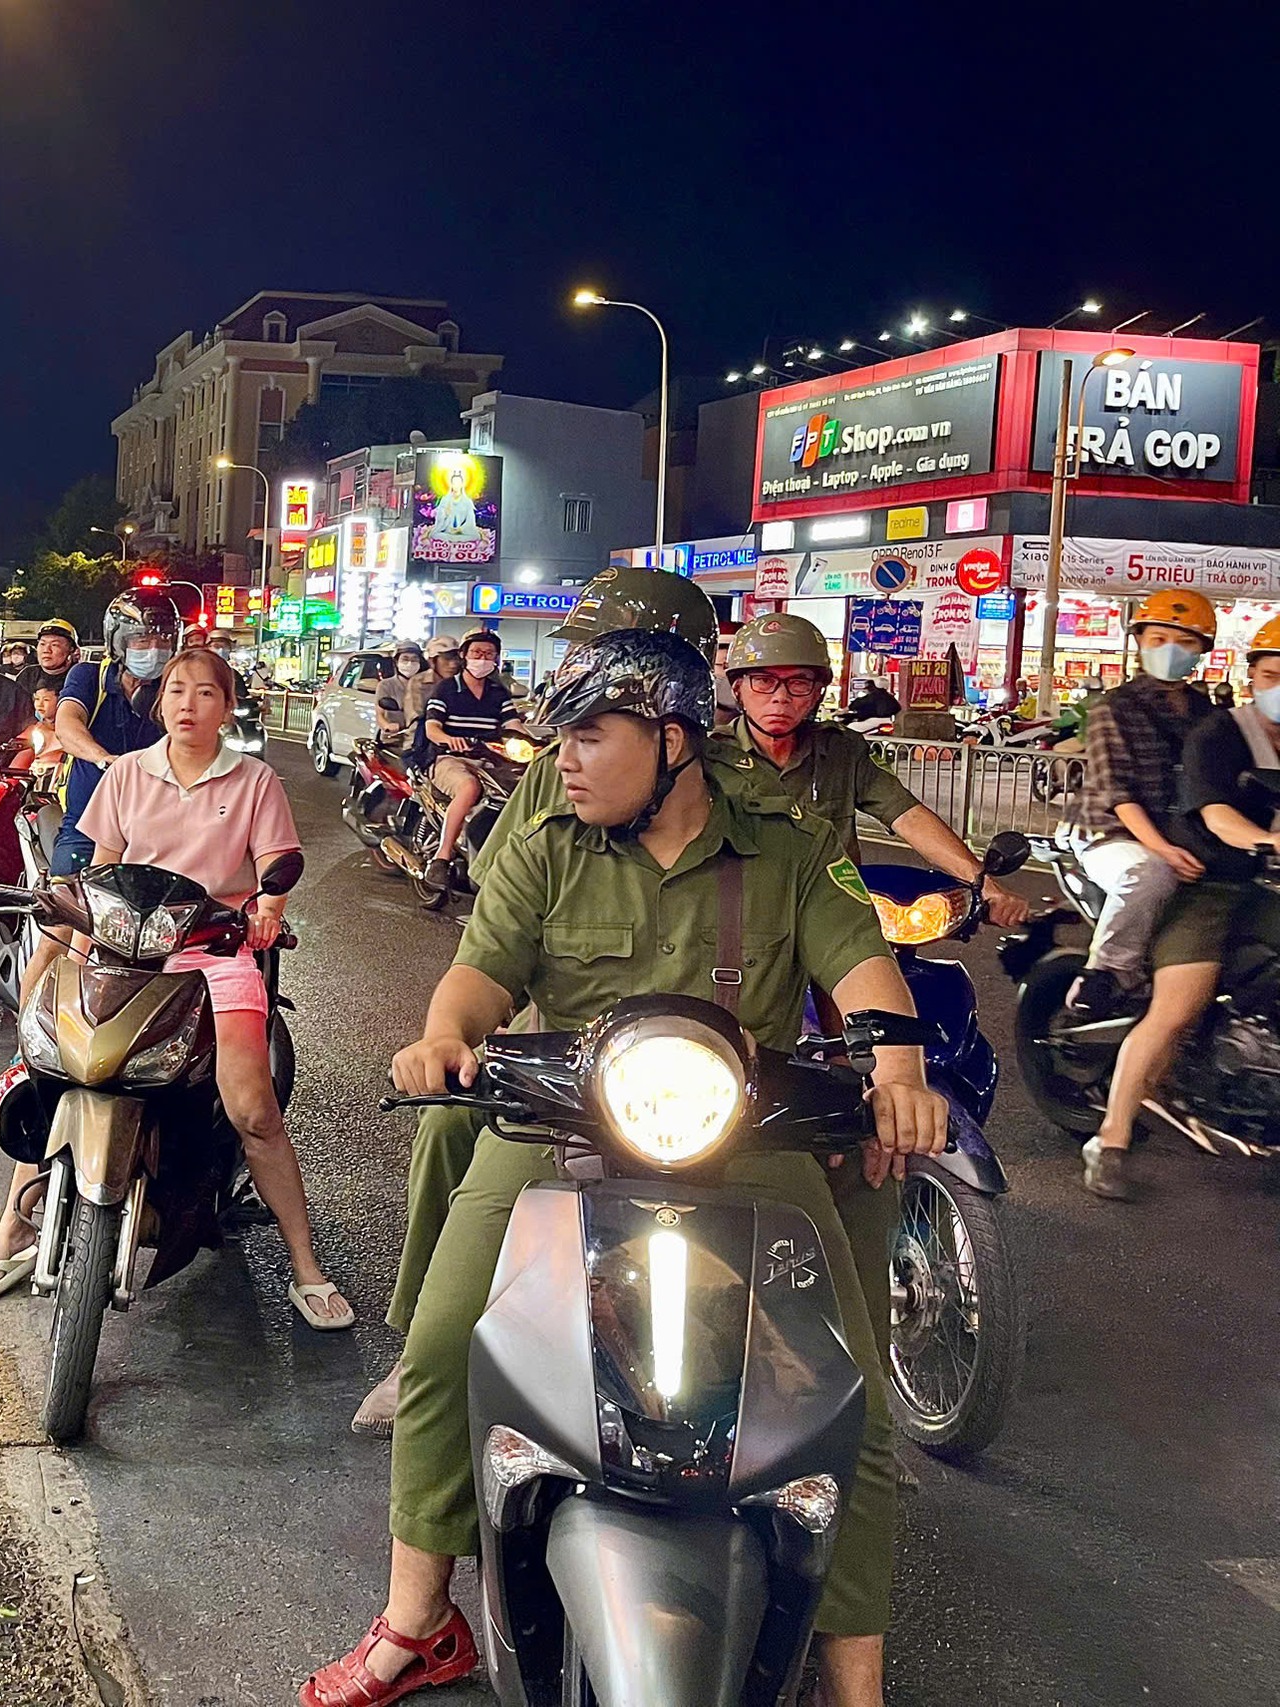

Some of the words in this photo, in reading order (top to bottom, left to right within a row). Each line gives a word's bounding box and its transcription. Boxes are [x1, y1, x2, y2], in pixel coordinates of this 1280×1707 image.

[1104, 359, 1183, 412] BÁN
[1143, 428, 1221, 470] GOP
[762, 479, 784, 497] Điện
[785, 475, 811, 495] thoại
[822, 470, 859, 489] Laptop
[870, 460, 903, 482] Apple
[916, 456, 936, 474] Gia
[937, 451, 970, 471] dụng
[889, 516, 920, 529] realme
[693, 548, 757, 569] PETROLIME
[1127, 554, 1144, 581] 5
[1206, 559, 1224, 568] BẢO
[1226, 561, 1251, 571] HÀNH
[1252, 562, 1267, 571] VIP
[1145, 564, 1195, 586] TRIỆU
[1207, 573, 1227, 584] TRẢ
[1229, 573, 1251, 585] GÓP
[911, 662, 932, 676] NET
[934, 661, 947, 676] 28
